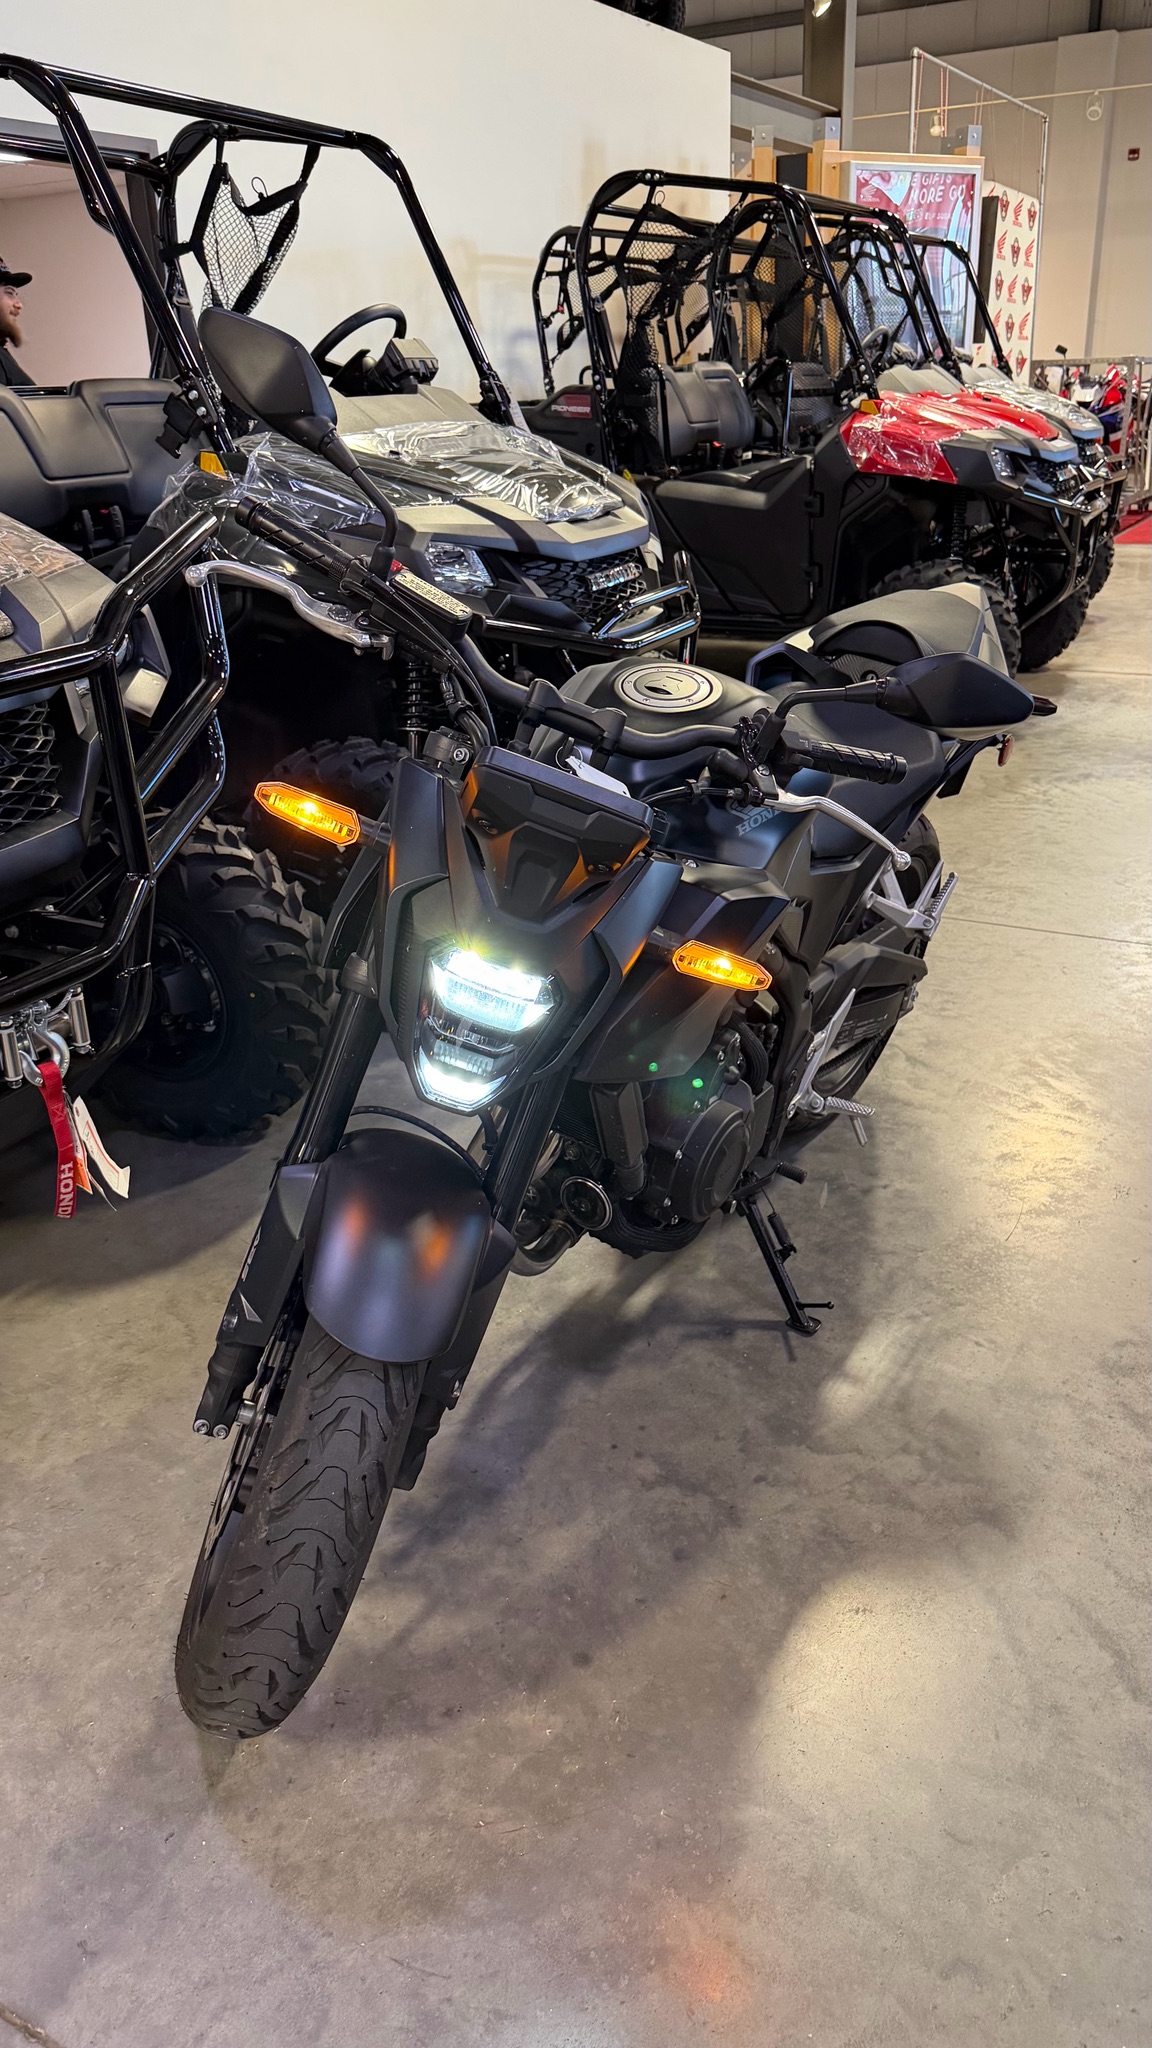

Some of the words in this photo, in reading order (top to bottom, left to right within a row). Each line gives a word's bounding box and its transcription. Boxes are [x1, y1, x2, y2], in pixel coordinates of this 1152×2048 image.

[908, 185, 945, 205] MORE
[551, 404, 591, 413] PIONEER
[57, 1161, 74, 1218] HOND
